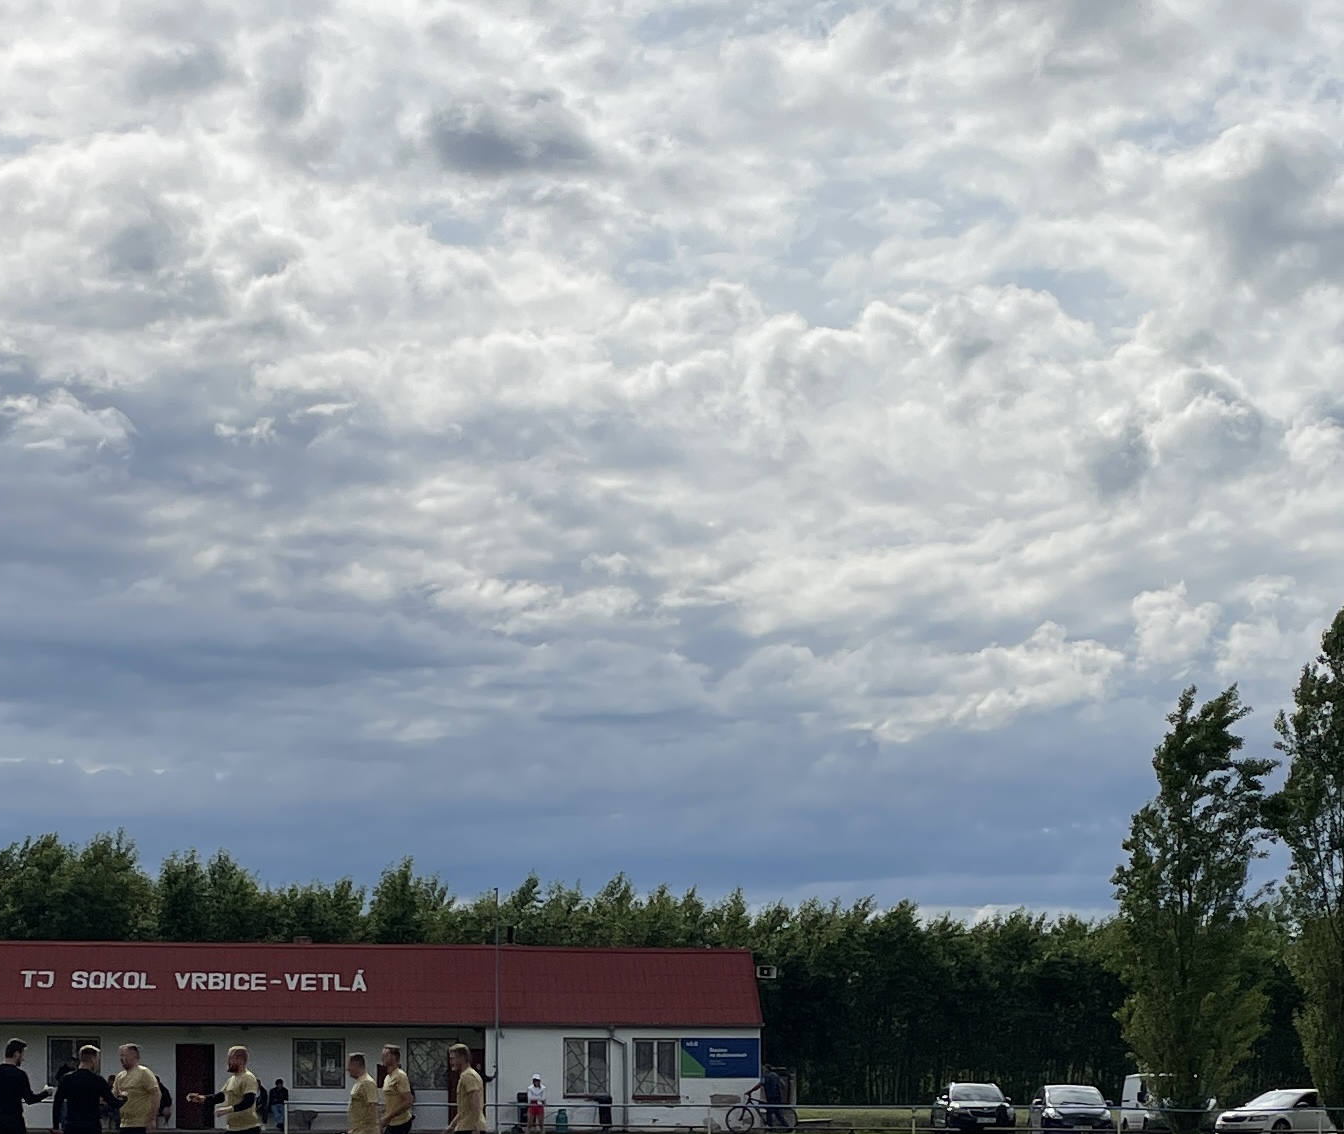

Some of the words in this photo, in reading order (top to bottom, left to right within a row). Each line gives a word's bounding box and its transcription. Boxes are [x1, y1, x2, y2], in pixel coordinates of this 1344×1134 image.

[20, 970, 55, 989] TJ
[71, 970, 157, 990] SOKOL
[174, 969, 368, 992] VRBICE-VETLÁ
